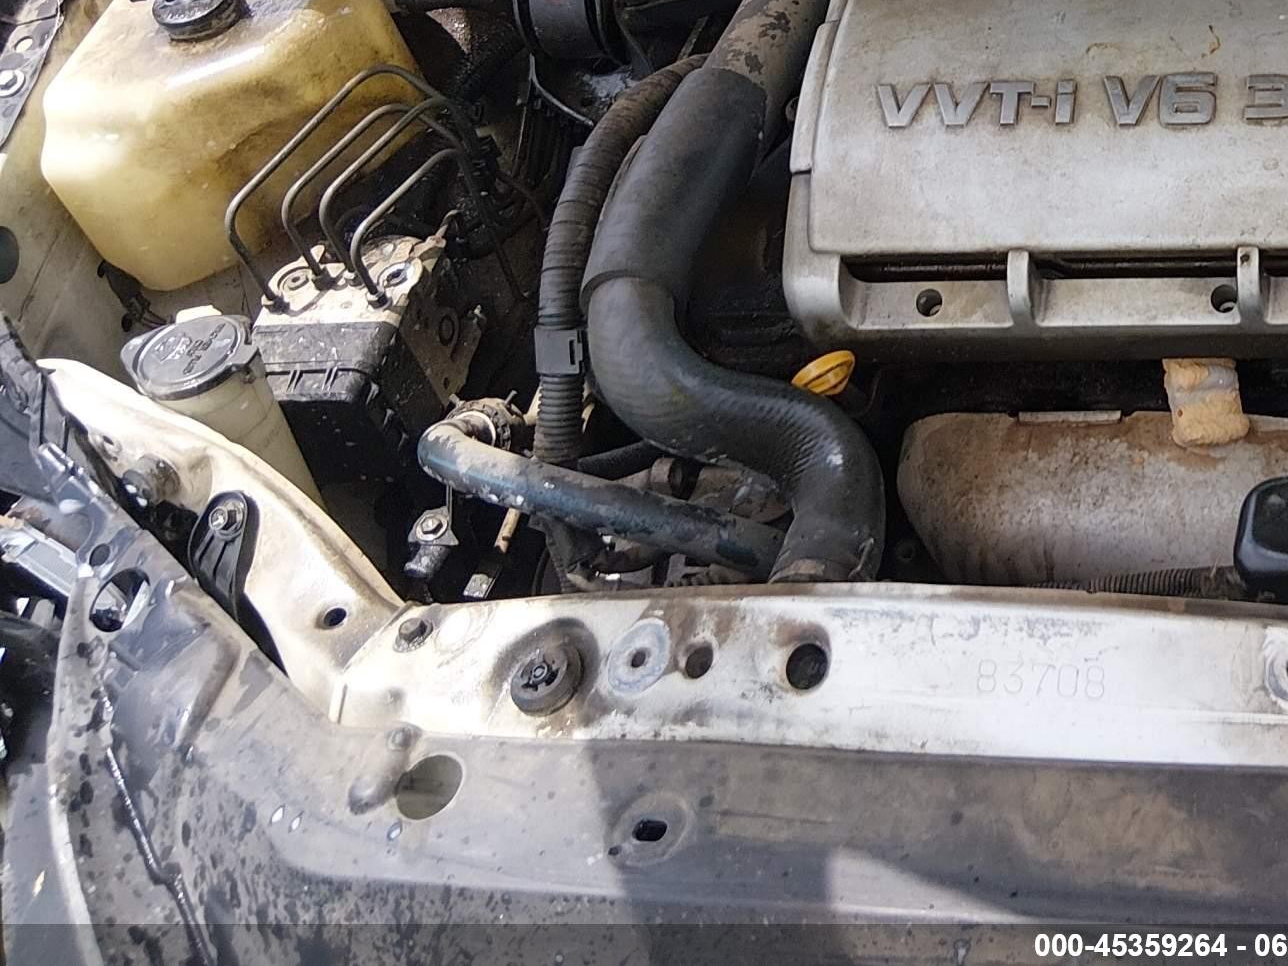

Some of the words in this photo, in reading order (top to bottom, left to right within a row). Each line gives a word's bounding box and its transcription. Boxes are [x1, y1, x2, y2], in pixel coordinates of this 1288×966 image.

[876, 80, 1078, 129] VVT-i
[1104, 72, 1218, 127] V6
[977, 659, 1105, 699] 83708
